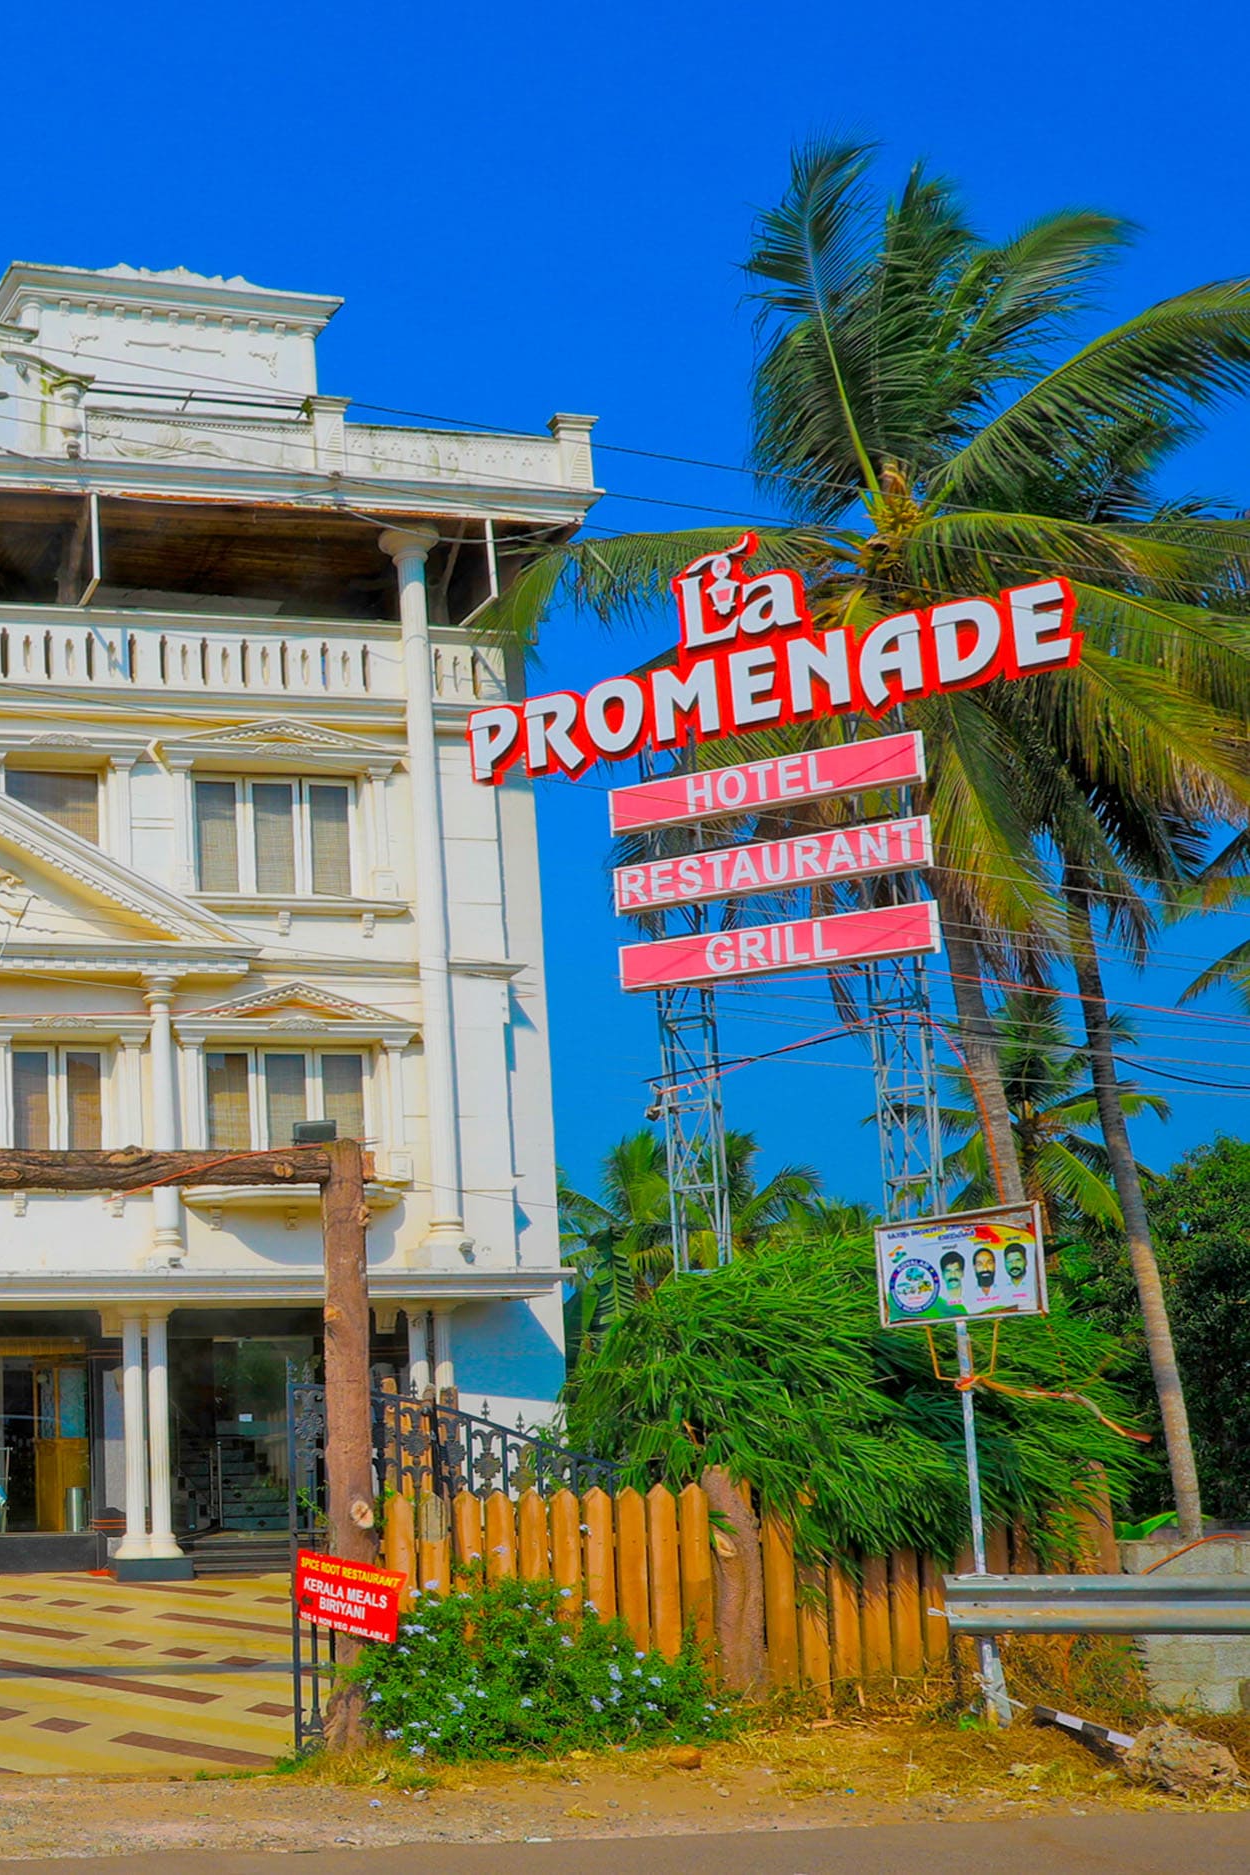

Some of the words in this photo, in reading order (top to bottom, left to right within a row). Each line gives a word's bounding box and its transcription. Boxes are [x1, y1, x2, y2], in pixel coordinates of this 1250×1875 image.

[676, 568, 802, 649] La
[468, 580, 1073, 781] PROMENADE
[686, 755, 833, 814] HOTEL
[620, 822, 919, 906] RESTAURANT
[704, 920, 838, 974] GRILL
[301, 1557, 320, 1571] SPICE
[321, 1562, 340, 1576] ROOT
[342, 1567, 401, 1588] RESTAURANT
[304, 1577, 344, 1599] KERALA
[347, 1588, 388, 1609] MEALS
[319, 1596, 366, 1620] BIRIYANI
[349, 1625, 390, 1642] AVAILABLE
